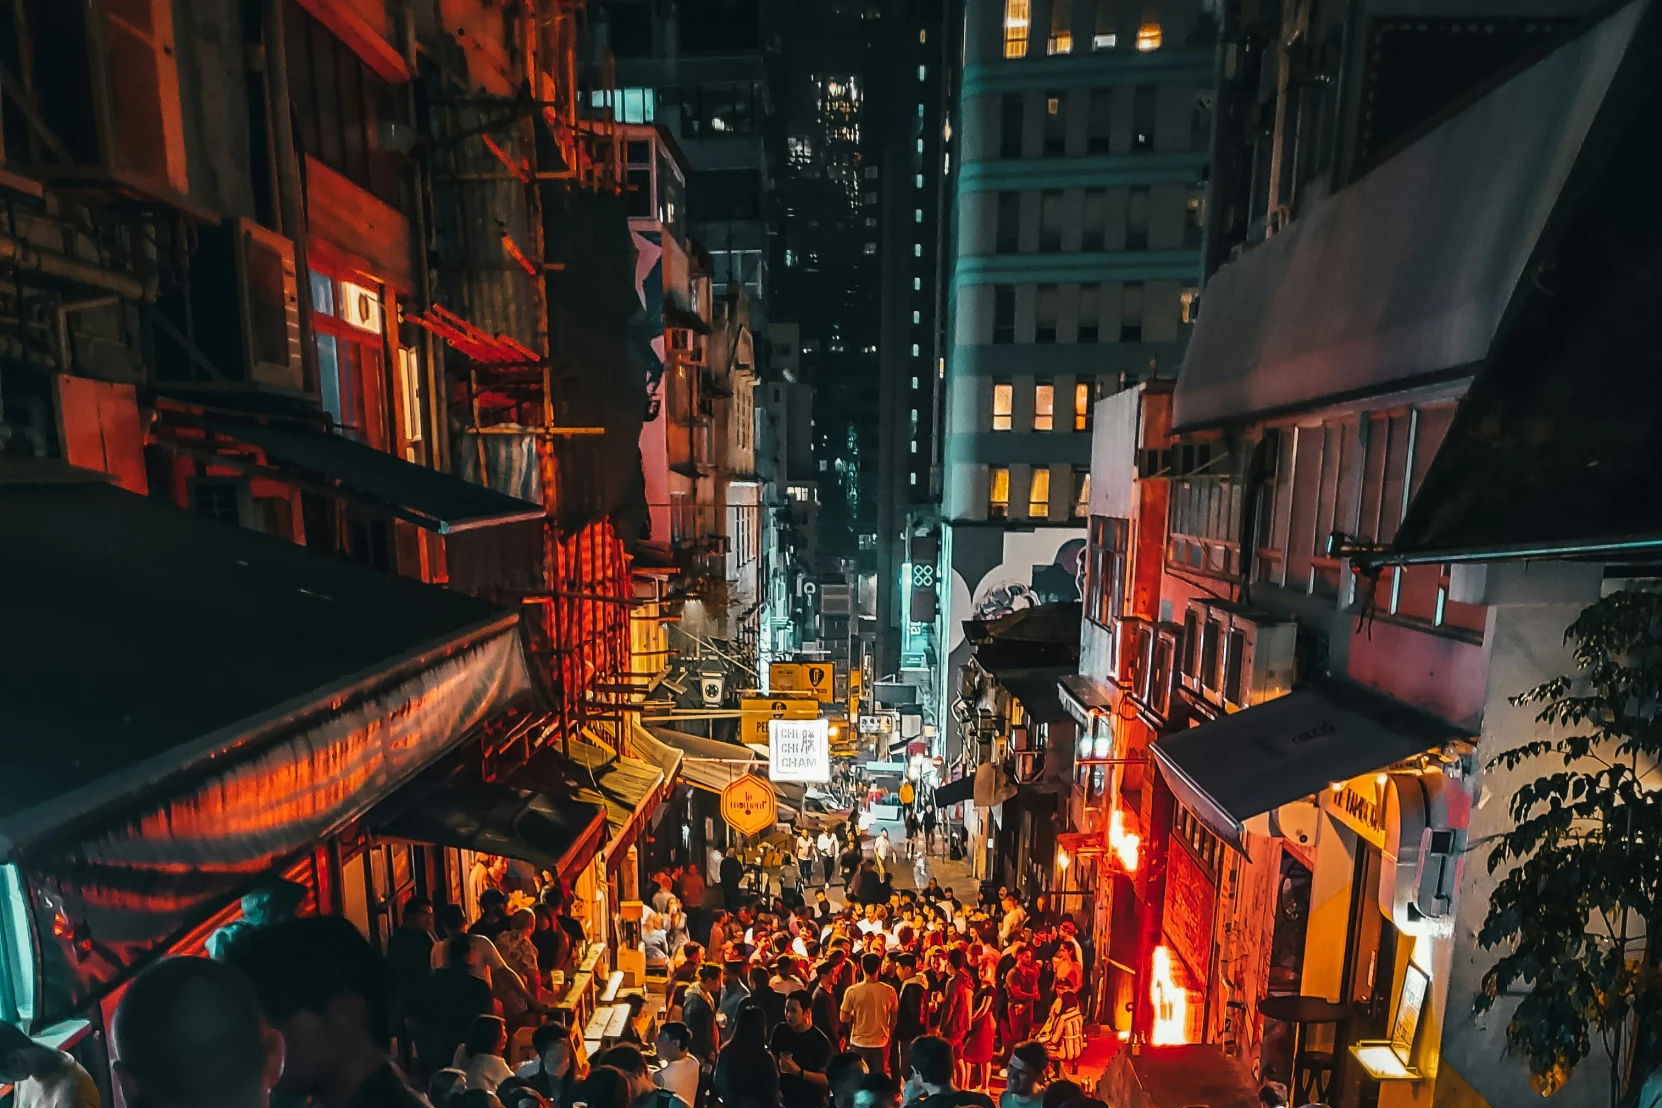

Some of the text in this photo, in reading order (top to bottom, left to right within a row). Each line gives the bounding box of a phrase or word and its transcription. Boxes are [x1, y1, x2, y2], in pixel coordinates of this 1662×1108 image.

[781, 757, 817, 768] CHAM
[745, 791, 753, 802] le
[730, 801, 767, 810] moment
